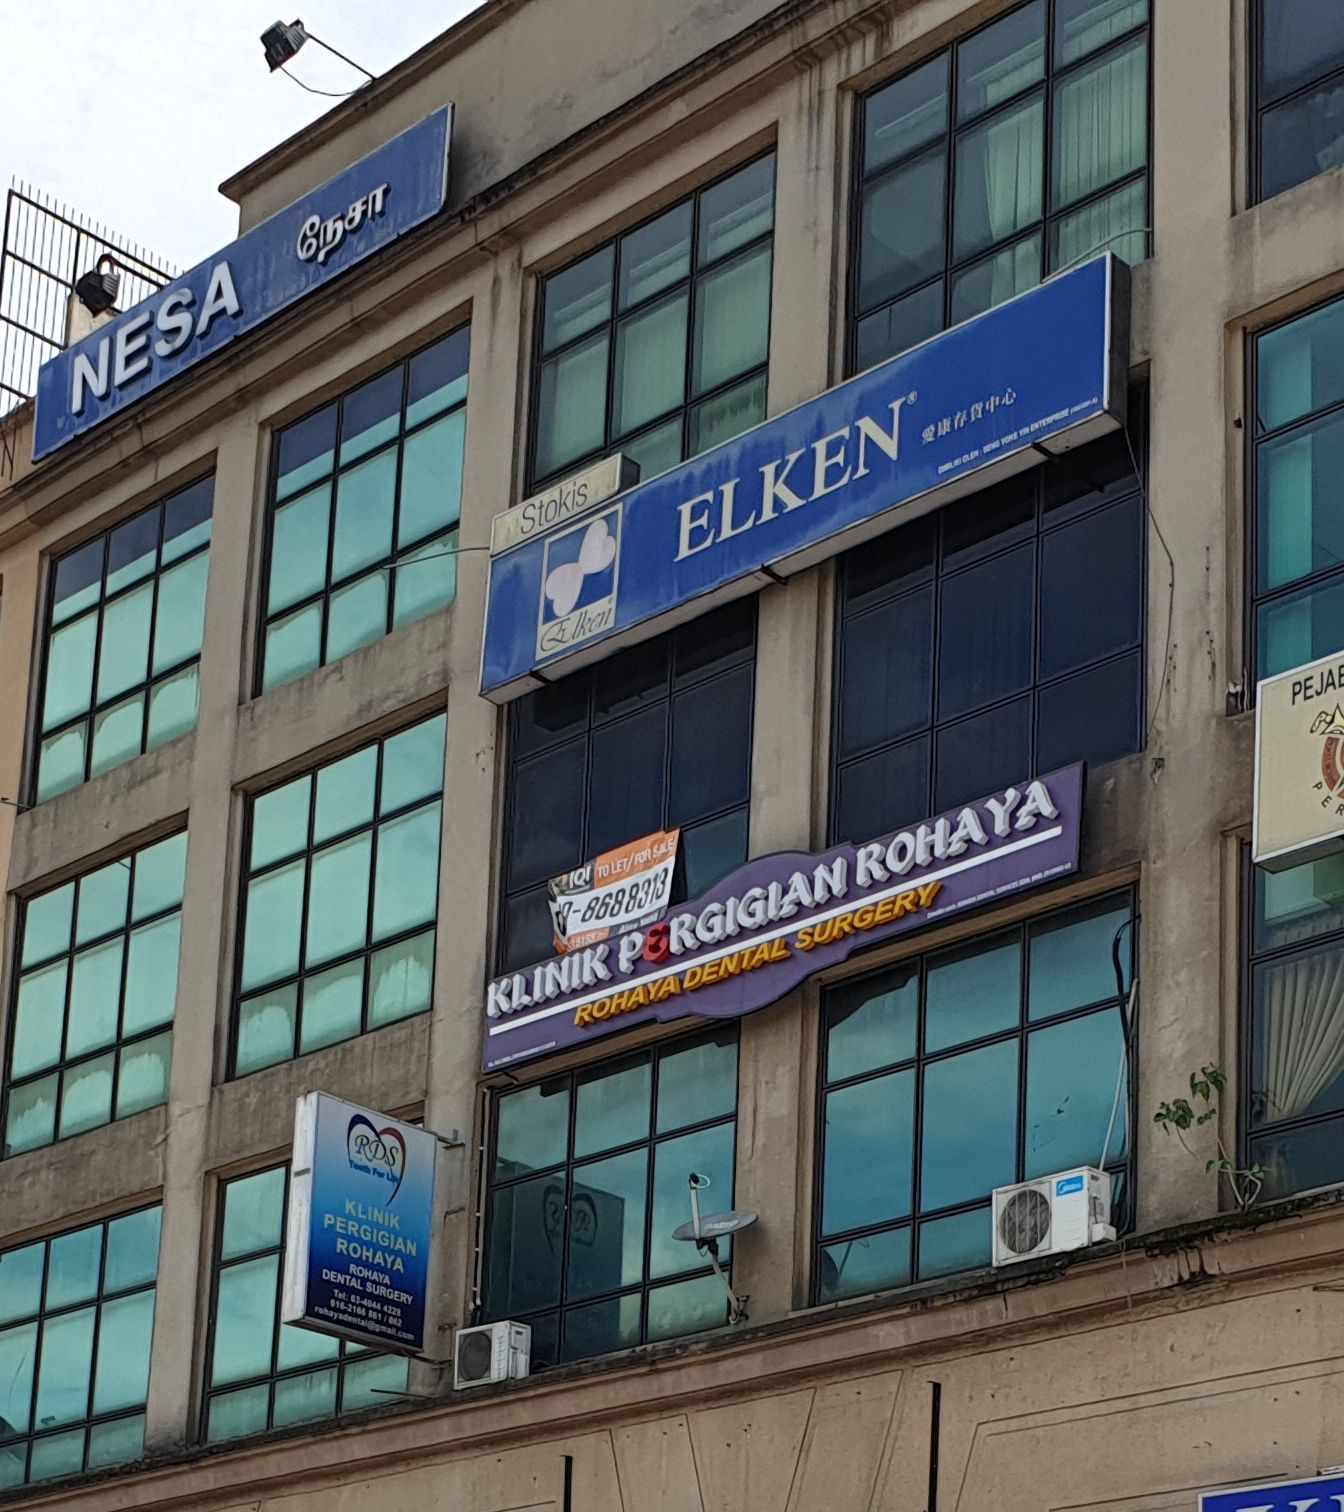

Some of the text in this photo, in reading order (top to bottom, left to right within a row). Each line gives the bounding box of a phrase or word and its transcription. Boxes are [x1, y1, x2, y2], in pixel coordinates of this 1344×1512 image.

[296, 182, 390, 263] நேசா
[71, 261, 242, 414] NESA
[1030, 408, 1069, 431] ENTERPRISE
[673, 400, 905, 561] ELKEN
[519, 481, 589, 535] Stokis
[539, 600, 613, 654] Elken
[598, 837, 675, 878] TO SALE
[486, 942, 611, 1018] KLINIK
[618, 856, 849, 974] PERGIGIAN
[855, 780, 1058, 889] ROHAYA
[574, 972, 681, 1026] ROHAYA
[683, 937, 791, 992] DENTAL
[794, 880, 943, 953] SURGERY
[355, 1135, 398, 1168] RDS
[323, 1214, 416, 1256] PERGIGIAN
[345, 1199, 400, 1230] KLINIK
[336, 1240, 404, 1274] ROHAYA
[349, 1264, 391, 1285] ROHAYA
[322, 1269, 413, 1305] DENTAL SURGERY
